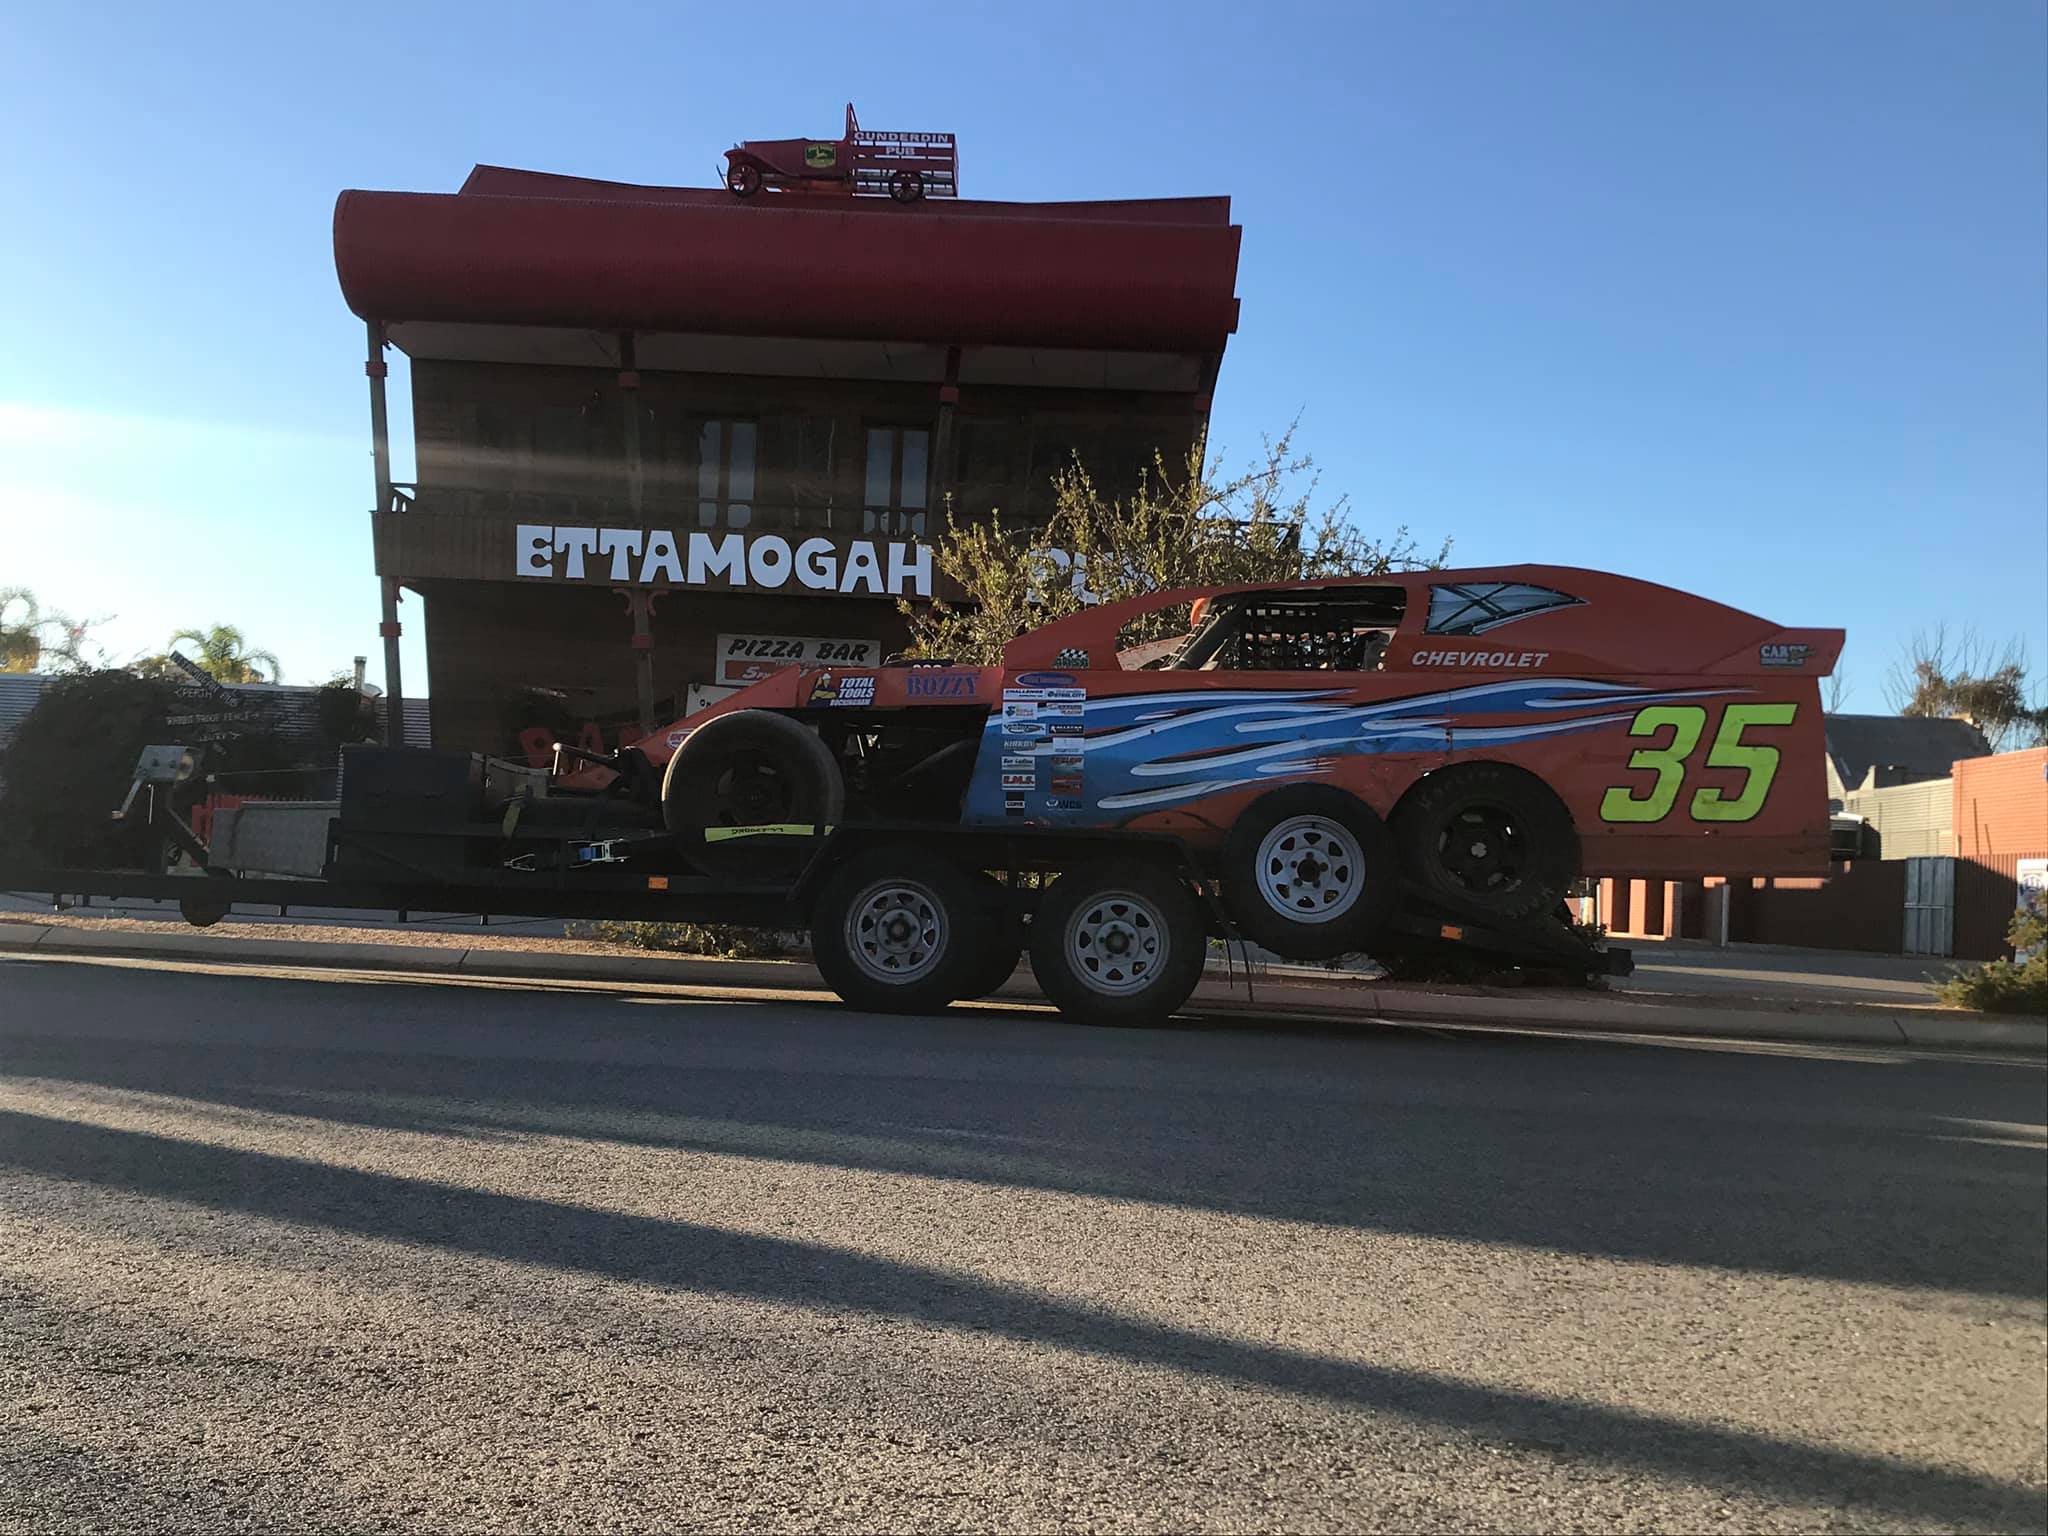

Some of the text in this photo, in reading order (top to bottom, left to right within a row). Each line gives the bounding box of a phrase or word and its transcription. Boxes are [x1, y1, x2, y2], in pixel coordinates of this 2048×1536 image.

[854, 132, 949, 143] CUNDERDIN
[886, 146, 915, 156] PUB
[516, 525, 933, 596] ETTAMOGAH
[728, 638, 871, 662] PIZZA BAR
[1412, 651, 1549, 668] CHEVROLET
[839, 676, 875, 688] TOTAL
[906, 672, 980, 697] BOZZY
[838, 688, 875, 699] TOOLS
[1599, 703, 1798, 823] 35
